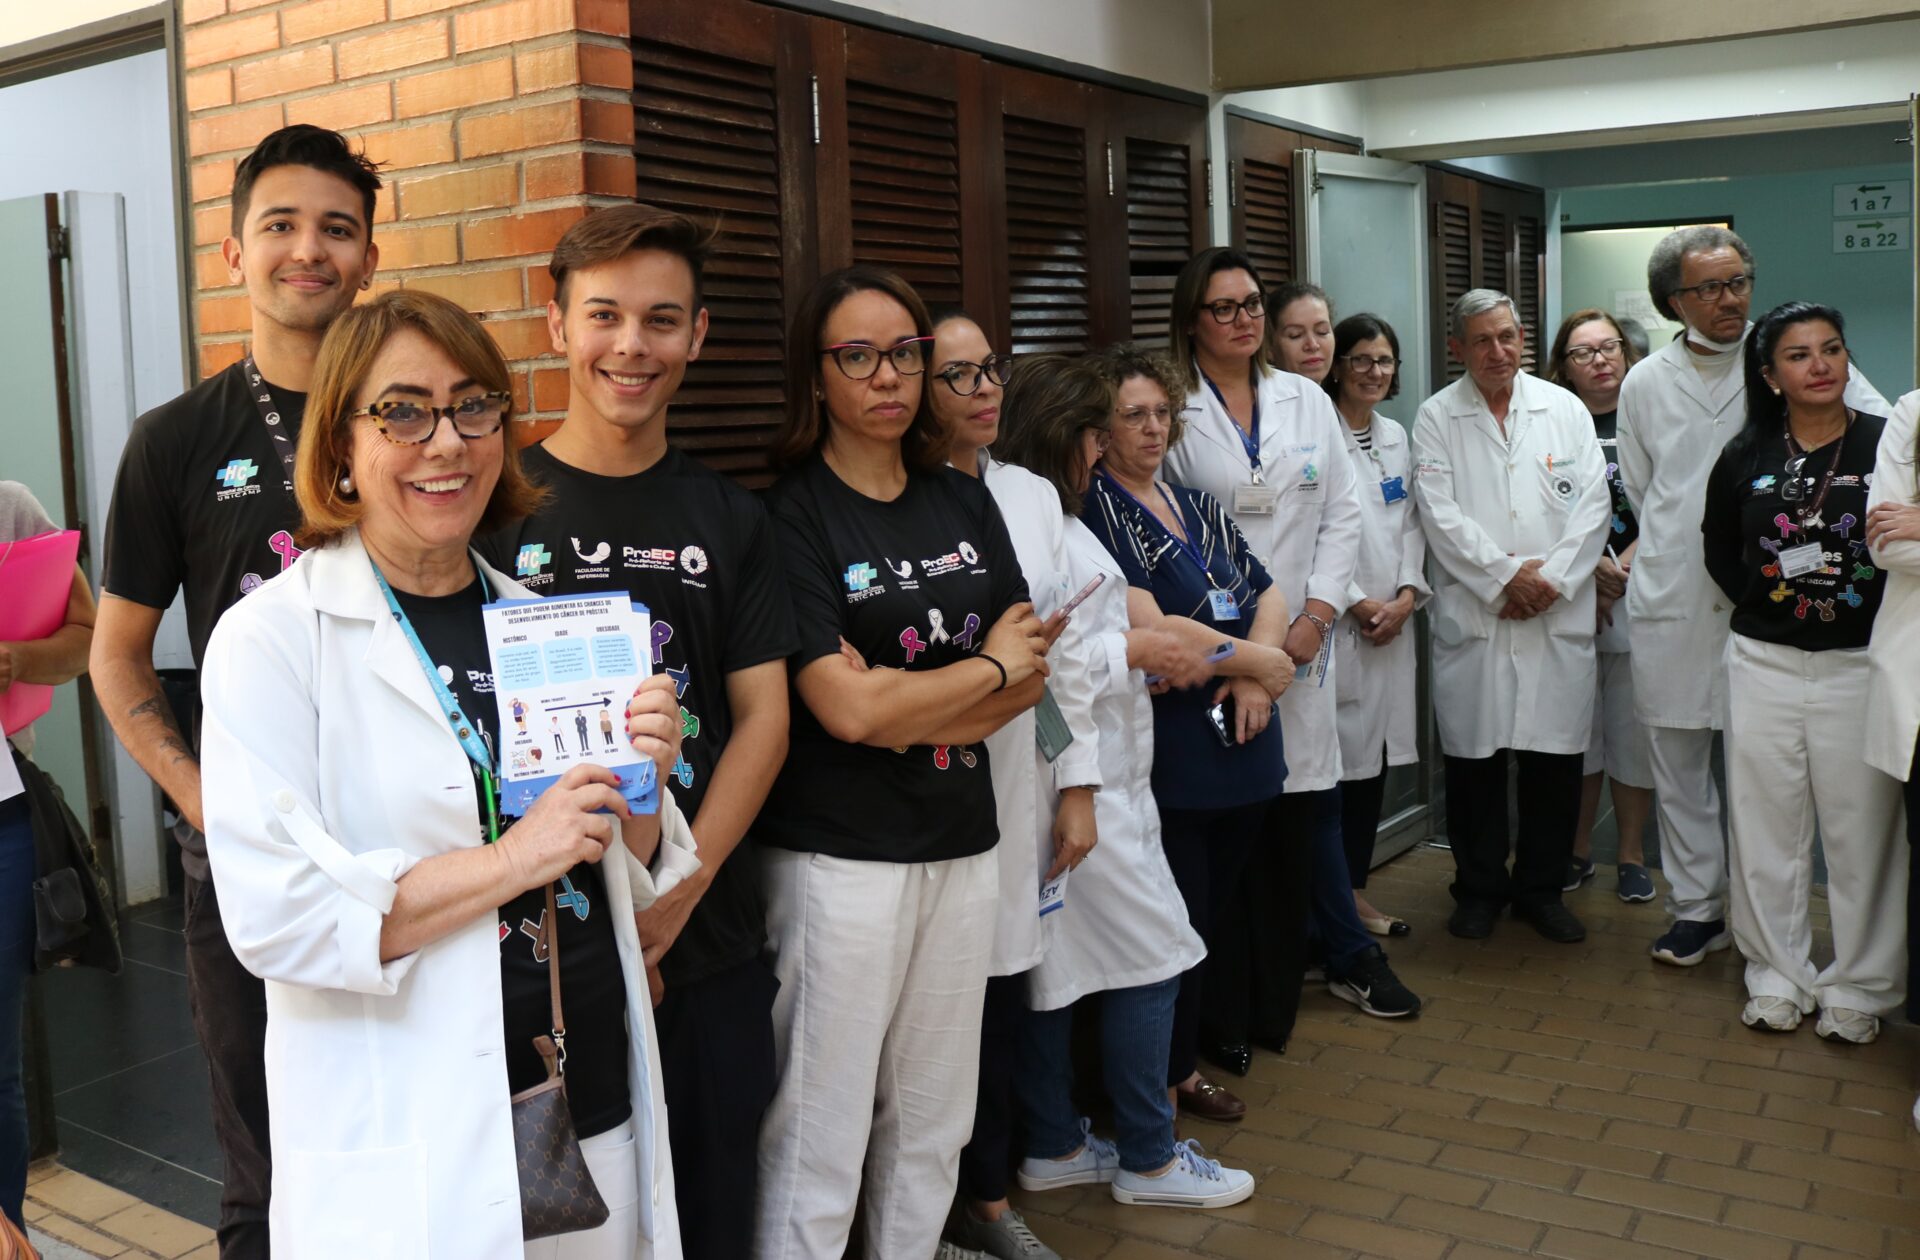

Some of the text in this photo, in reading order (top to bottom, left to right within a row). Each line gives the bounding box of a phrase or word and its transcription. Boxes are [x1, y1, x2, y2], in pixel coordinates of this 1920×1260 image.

[1850, 196, 1892, 211] 1 a 7
[1845, 232, 1897, 248] 8 a 22
[225, 464, 247, 480] HC
[217, 490, 261, 501] UNICAMP
[519, 551, 539, 568] HC
[623, 547, 676, 561] ProEC
[921, 553, 960, 569] ProEC
[1822, 551, 1843, 562] es
[681, 578, 707, 588] UNICAMP
[849, 569, 868, 585] HC
[1807, 578, 1836, 586] UNICAMP
[848, 589, 886, 603] UNICAMP
[502, 607, 522, 617] FATORES
[533, 605, 550, 613] PODEM
[551, 602, 576, 611] AUMENTAR
[584, 600, 604, 608] CHANCES
[508, 613, 552, 625] DESENVOLVIMENTO
[560, 610, 578, 618] CÂNCER
[586, 608, 609, 616] PRÓSTATA
[466, 670, 494, 681] Pro
